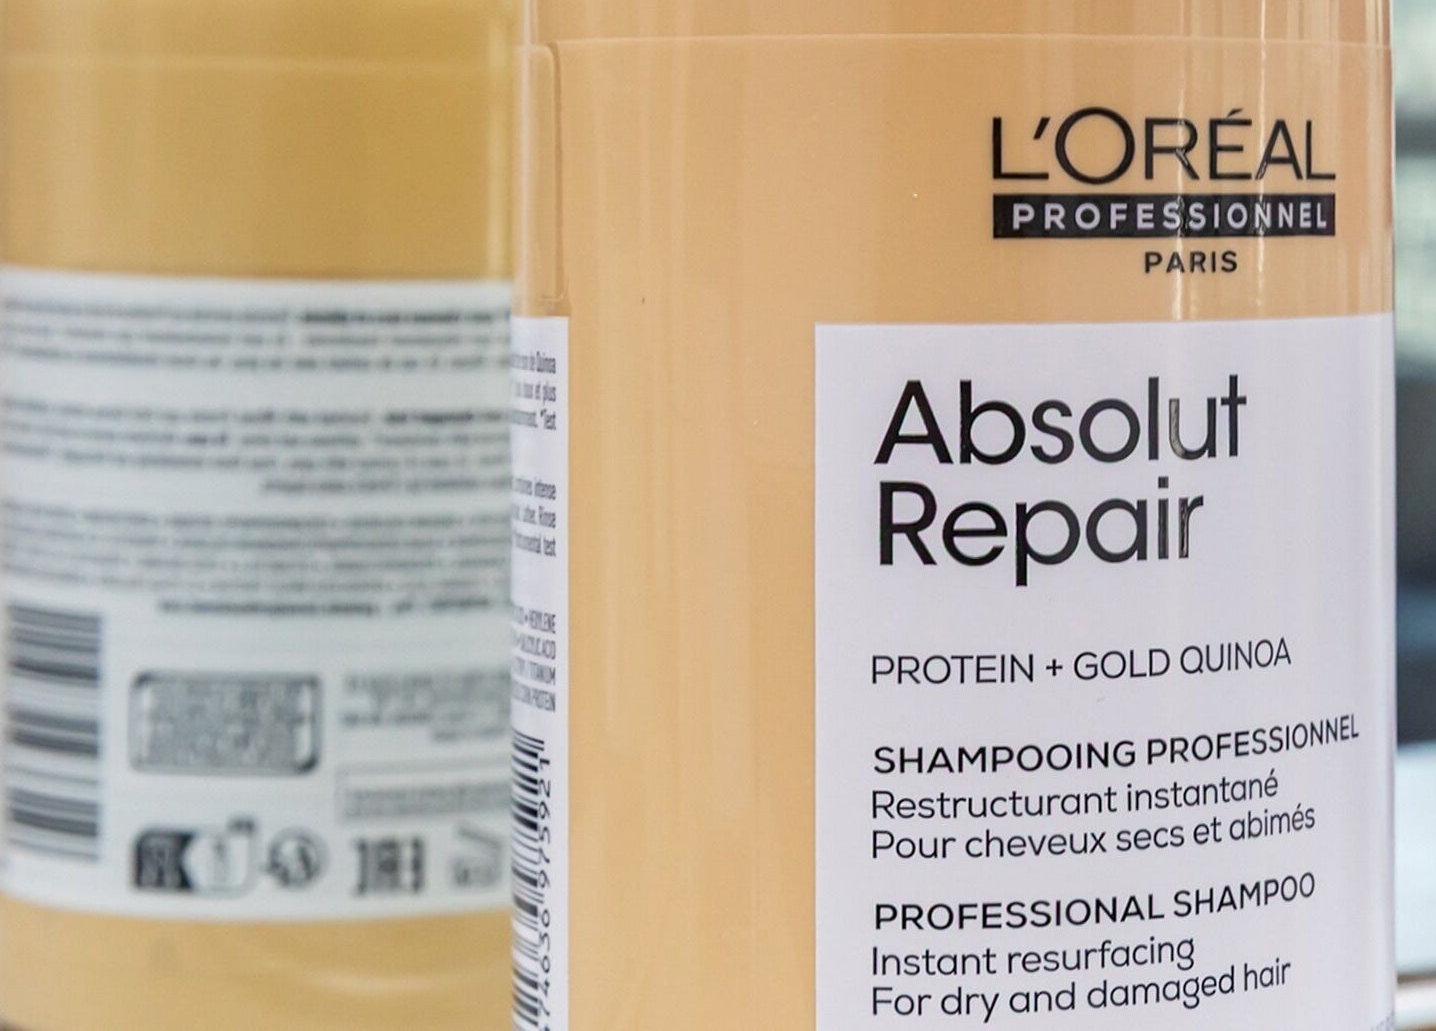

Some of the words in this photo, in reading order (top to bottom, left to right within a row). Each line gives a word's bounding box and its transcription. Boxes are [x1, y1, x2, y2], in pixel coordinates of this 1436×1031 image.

[992, 106, 1336, 185] L'ORÉAL
[1012, 202, 1327, 230] PROFESSIONNEL
[1144, 251, 1238, 274] PARIS
[874, 374, 1247, 465] Absolut
[879, 476, 1204, 587] Repair
[872, 654, 1034, 685] PROTEIN
[1045, 660, 1063, 678] +
[1073, 649, 1170, 681] GOLD
[1180, 637, 1291, 674] QUINOA
[873, 740, 1136, 774] SHAMPOOING
[1147, 714, 1359, 765] PROFESSIONNEL
[872, 786, 1117, 819] Restructurant
[1126, 769, 1278, 812] instantané
[872, 830, 955, 859] Pour
[965, 824, 1106, 858] cheveux
[1116, 822, 1185, 851] secs
[1193, 816, 1222, 844] et
[1229, 803, 1315, 841] abimés
[875, 894, 1164, 930] PROFESSIONAL
[1173, 872, 1315, 918] SHAMPOO
[872, 946, 997, 976] Instant
[1008, 937, 1194, 972] resurfacing
[872, 986, 931, 1015] For
[941, 984, 999, 1023] dry
[1009, 981, 1076, 1013] and
[1087, 964, 1235, 1009] damaged
[1243, 959, 1291, 991] hair
